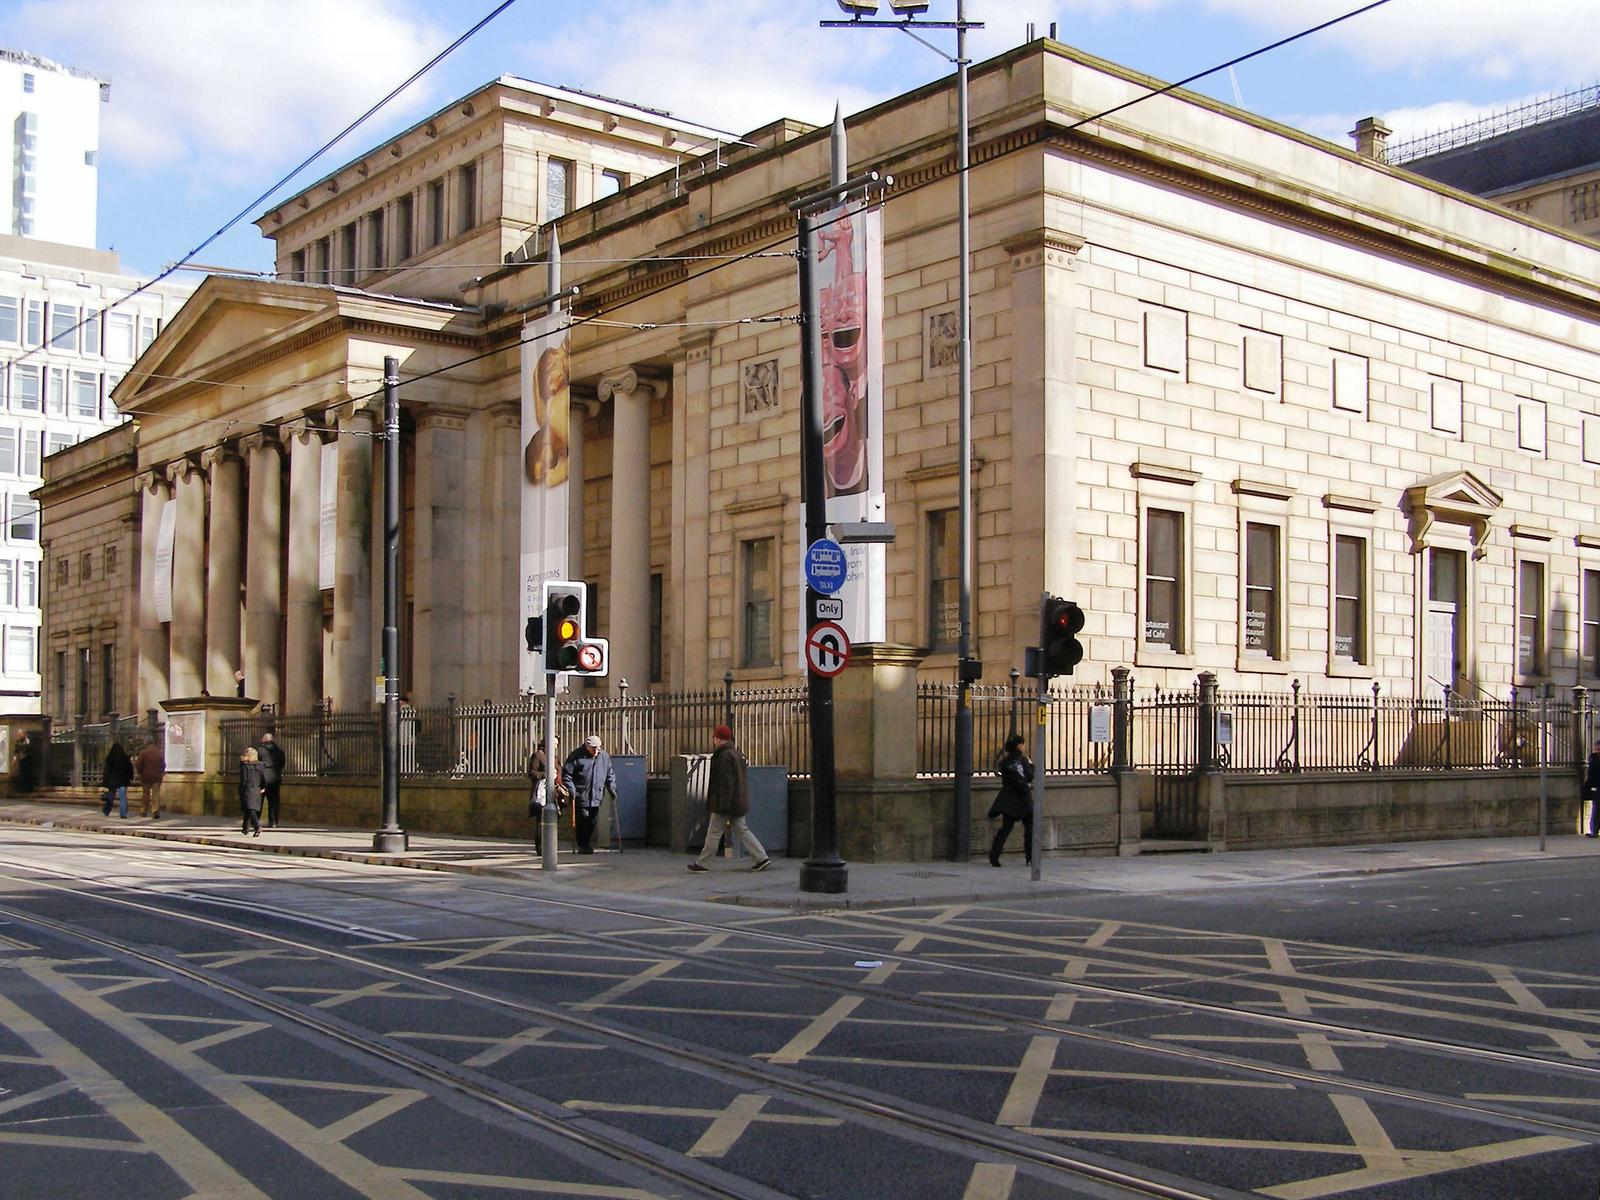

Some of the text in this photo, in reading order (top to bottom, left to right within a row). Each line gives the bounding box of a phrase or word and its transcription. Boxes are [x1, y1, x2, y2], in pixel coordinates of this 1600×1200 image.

[847, 560, 862, 569] rom
[846, 571, 865, 582] ohen
[819, 581, 834, 590] TAXI
[819, 603, 839, 615] Only
